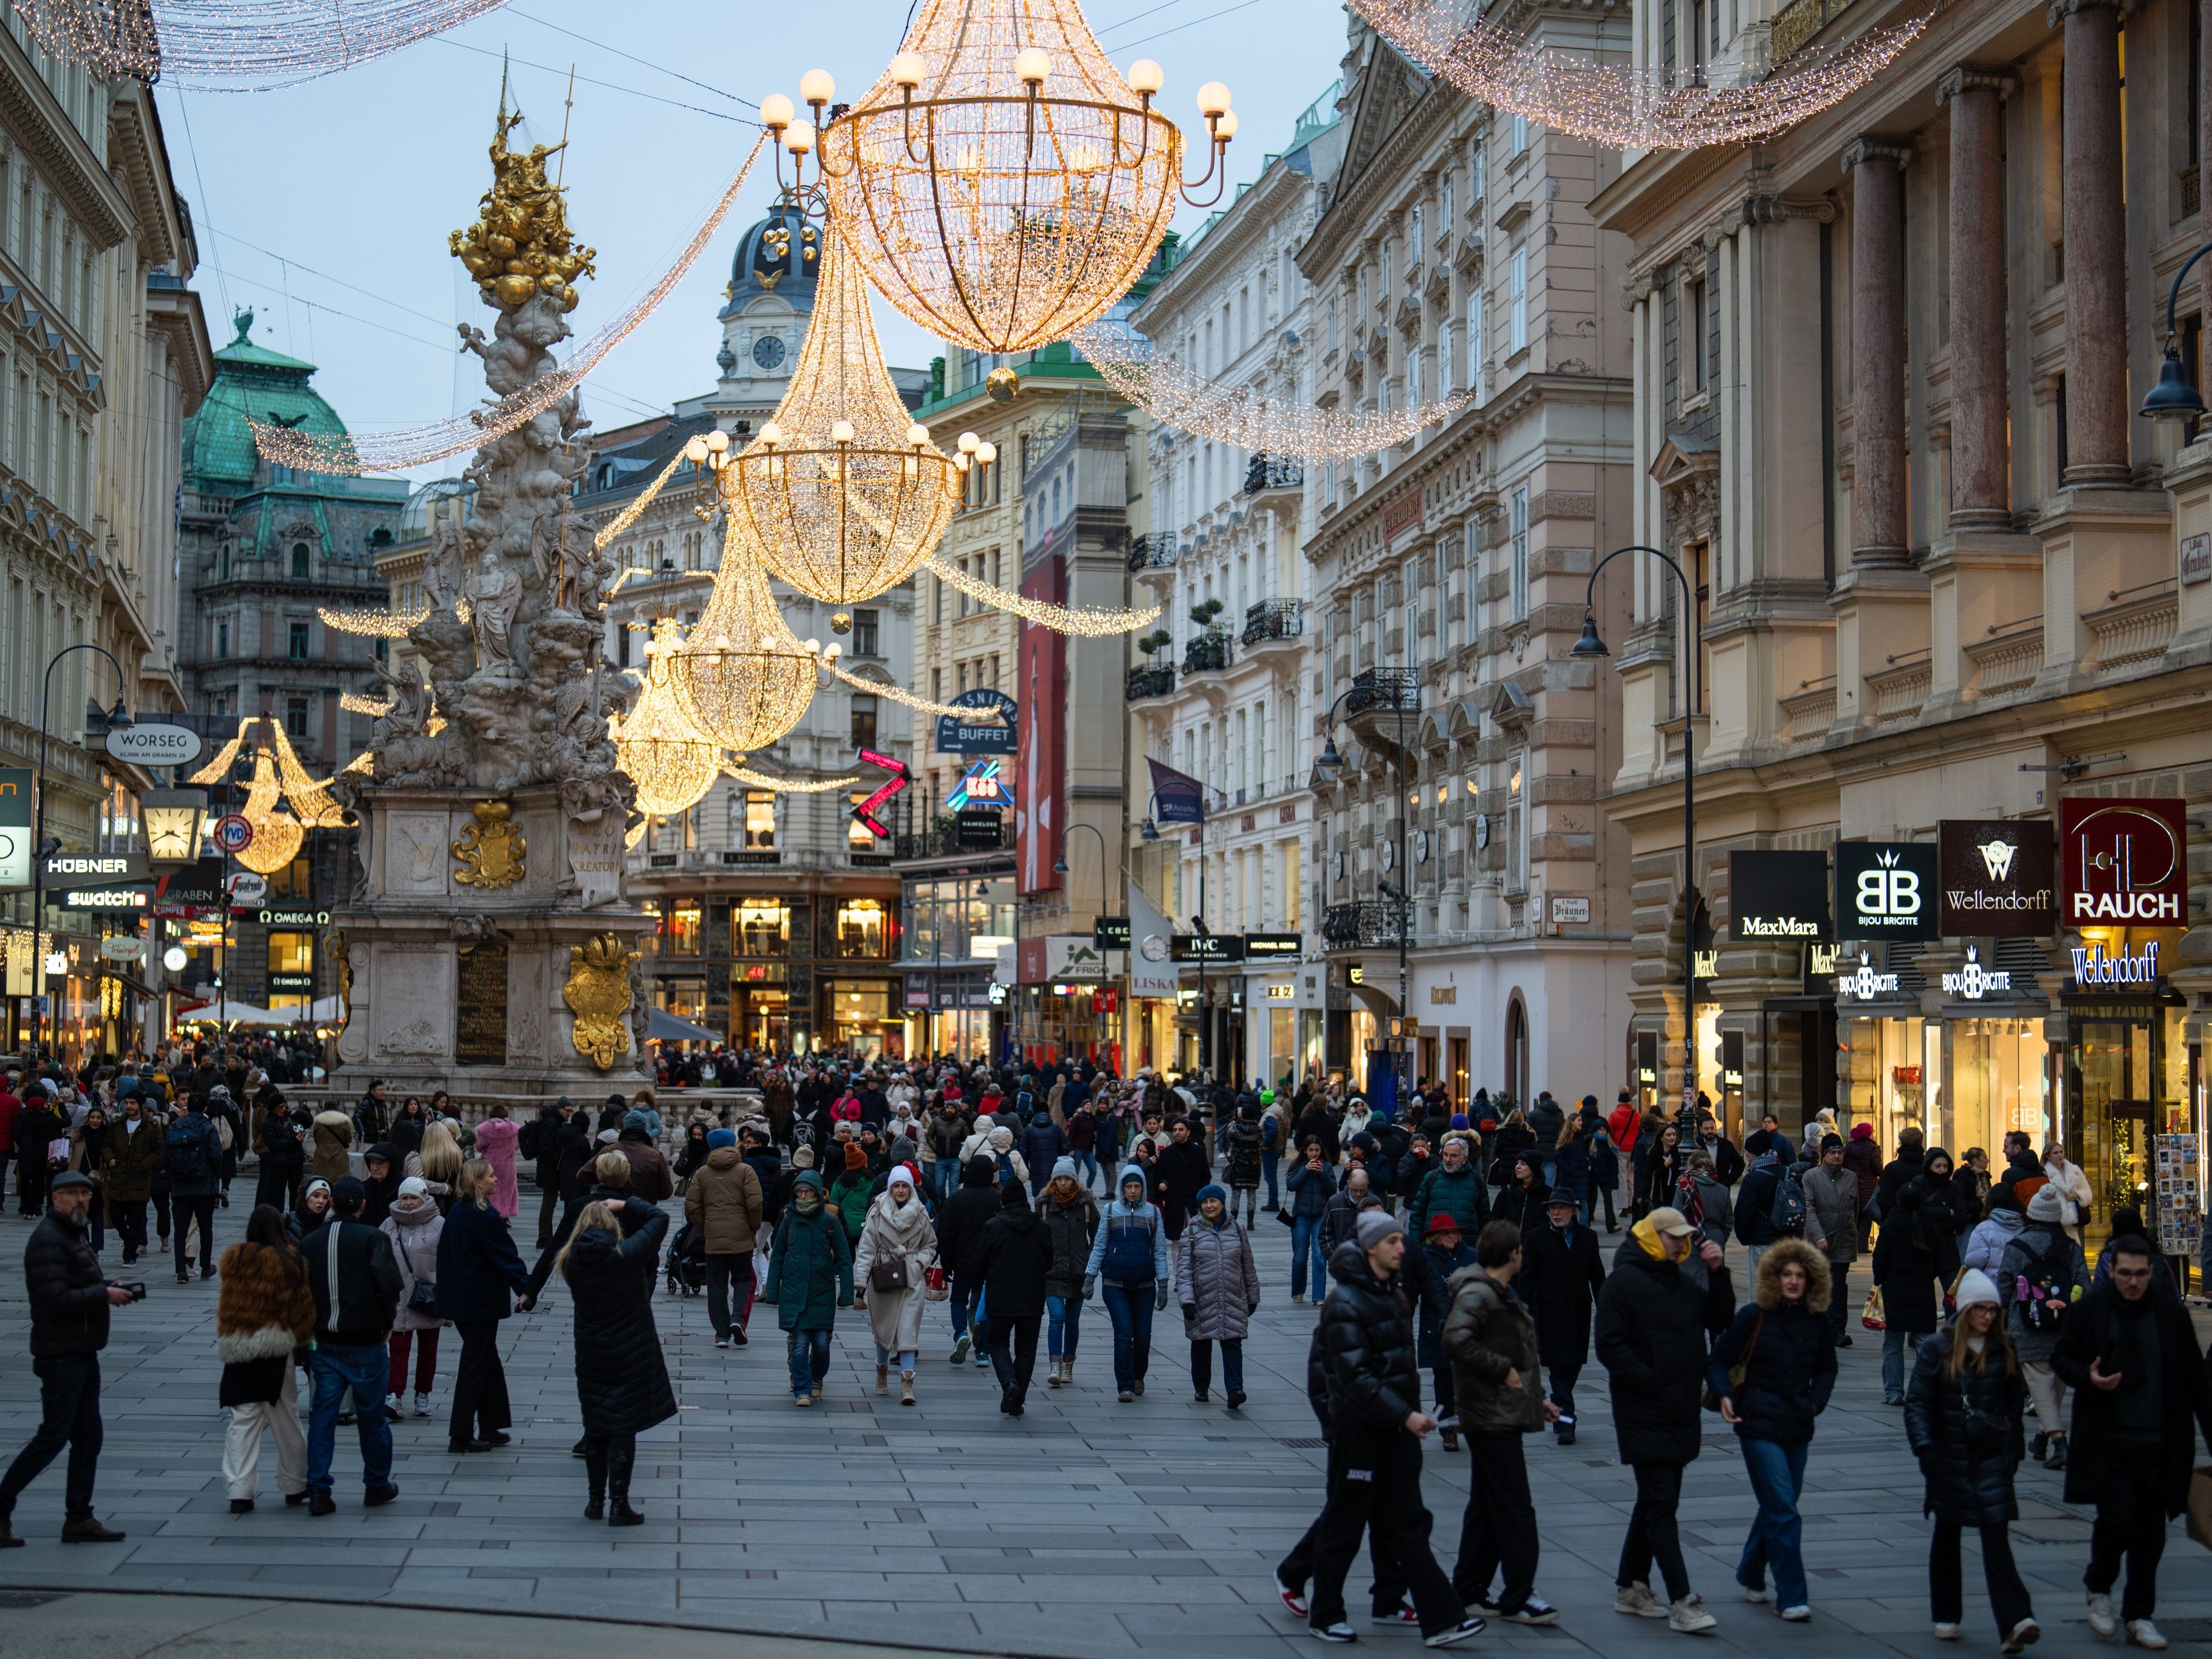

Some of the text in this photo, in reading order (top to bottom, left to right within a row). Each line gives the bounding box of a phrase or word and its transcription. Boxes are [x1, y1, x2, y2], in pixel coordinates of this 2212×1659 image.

[121, 734, 187, 747] WORSEG
[959, 728, 1009, 741] BUFFET
[967, 777, 998, 797] Köö
[1173, 804, 1196, 813] Aristo
[578, 821, 615, 836] DEO
[573, 841, 617, 855] PATRI
[48, 859, 128, 873] HÜBNER
[574, 860, 619, 872] CREATORI
[68, 891, 135, 906] swatch
[166, 889, 212, 901] GRABEN
[1947, 890, 2050, 911] Wellendorff
[156, 905, 185, 917] CAMPER
[2074, 893, 2179, 918] RAUCH
[274, 912, 313, 923] OMEGA
[1858, 917, 1918, 926] BIJOU BRIGITTE
[1742, 917, 1818, 936] MaxMara
[104, 943, 140, 957] Triumph
[1191, 939, 1217, 951] IWC
[2071, 942, 2159, 985] Wellendorff
[1134, 977, 1175, 989] LISKA
